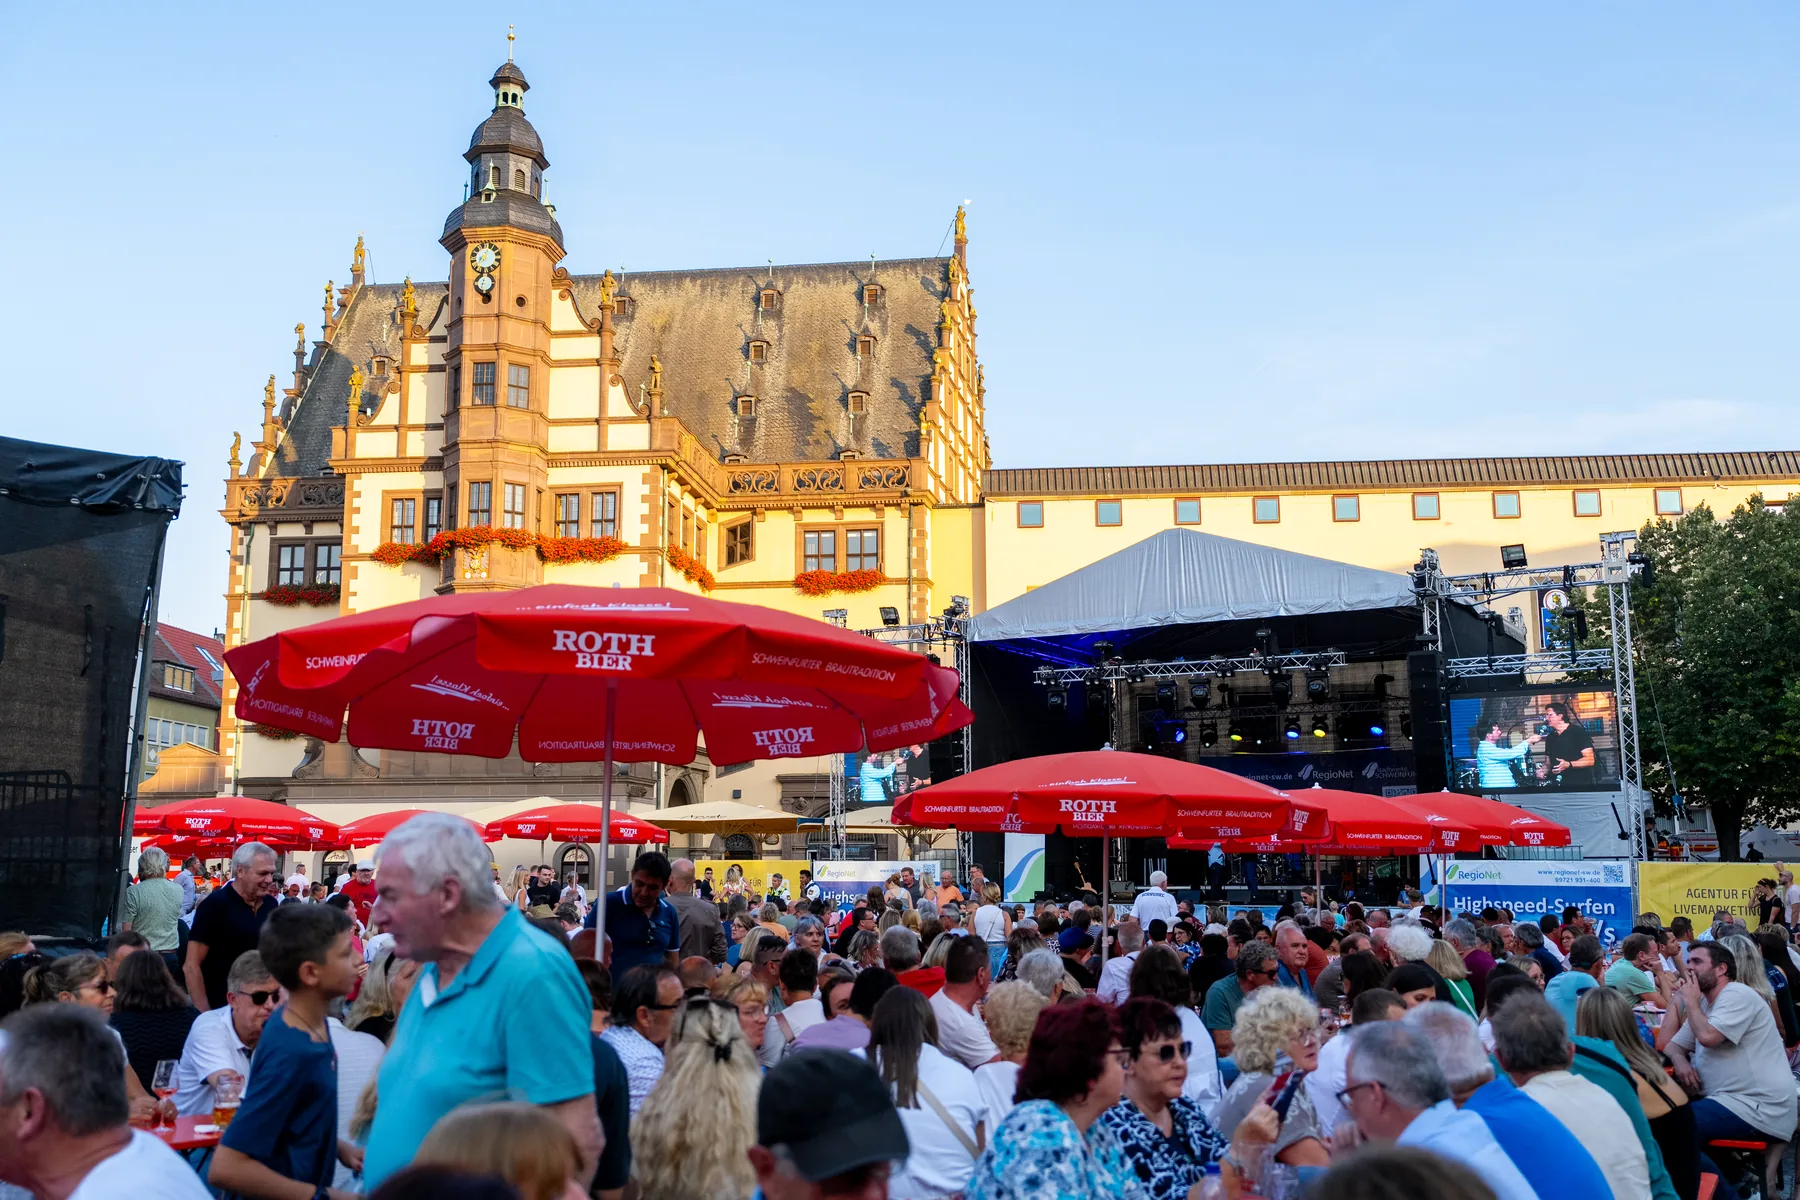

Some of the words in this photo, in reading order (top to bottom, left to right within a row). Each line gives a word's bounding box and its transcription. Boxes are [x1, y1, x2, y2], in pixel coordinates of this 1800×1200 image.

[552, 629, 656, 657] ROTH
[575, 652, 632, 671] BIER
[752, 652, 823, 671] SCHWEINFURTER
[824, 661, 896, 682] BRAUTRADITION
[1312, 770, 1354, 780] RegioNet
[924, 805, 967, 813] SCHWEINFURTER
[968, 805, 1005, 813] BRAUTRADITION
[1059, 799, 1117, 813] ROTH
[1072, 811, 1105, 822] BIER
[1177, 809, 1223, 817] SCHWEINFURTER
[1225, 810, 1272, 819] BRAUTRADITION
[1293, 808, 1309, 824] ROTH
[185, 817, 212, 825] ROTH
[517, 823, 536, 831] ROTH
[619, 827, 638, 835] ROTH
[1384, 833, 1423, 841] BRAUTRADITION
[1441, 830, 1460, 841] ROTH
[1523, 832, 1545, 840] ROTH
[827, 869, 856, 878] RegioNet
[1458, 870, 1502, 881] RegioNet
[1686, 888, 1738, 899] AGENTUR
[1741, 887, 1756, 900] FÜ
